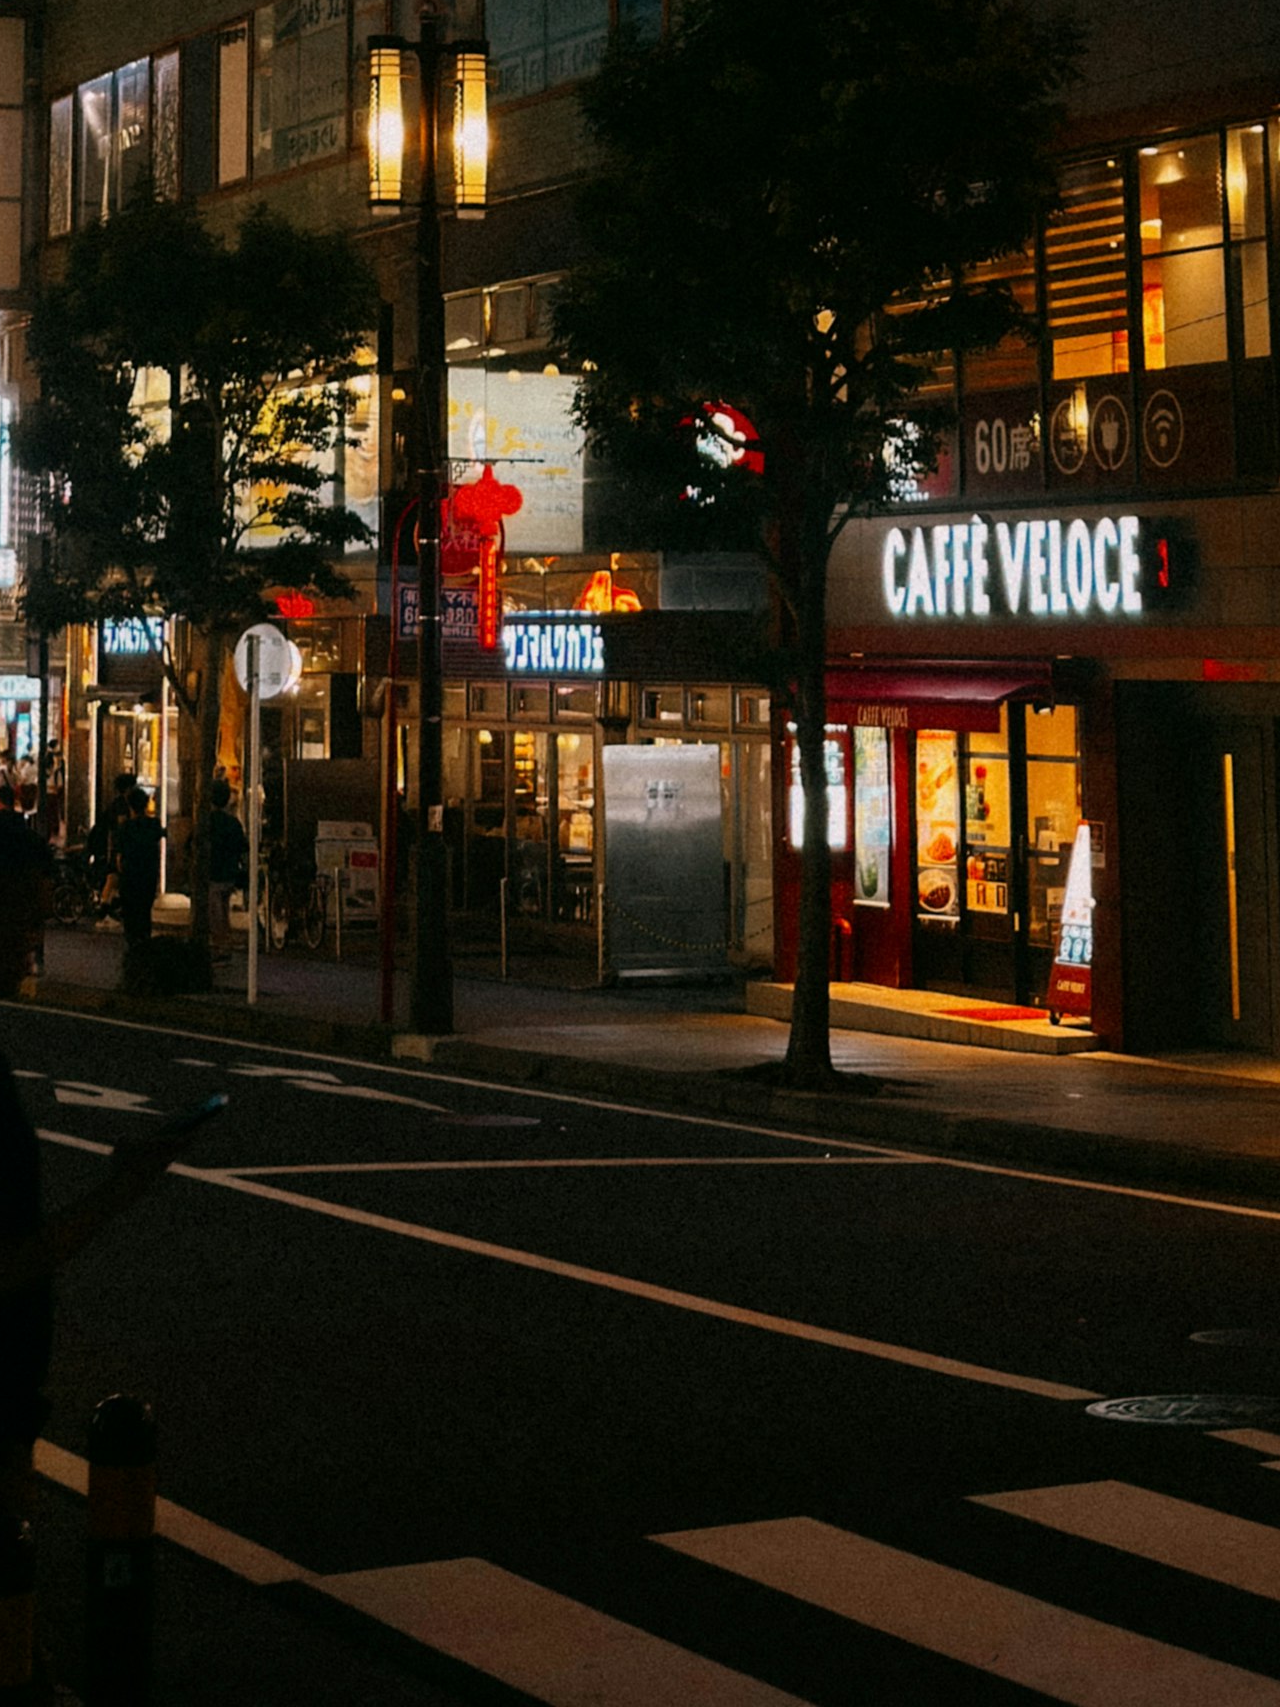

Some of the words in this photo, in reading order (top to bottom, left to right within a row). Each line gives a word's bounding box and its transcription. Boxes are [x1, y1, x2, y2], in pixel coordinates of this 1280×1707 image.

[995, 515, 1143, 615] VELOCE
[503, 623, 605, 672] サンマルクカフェ
